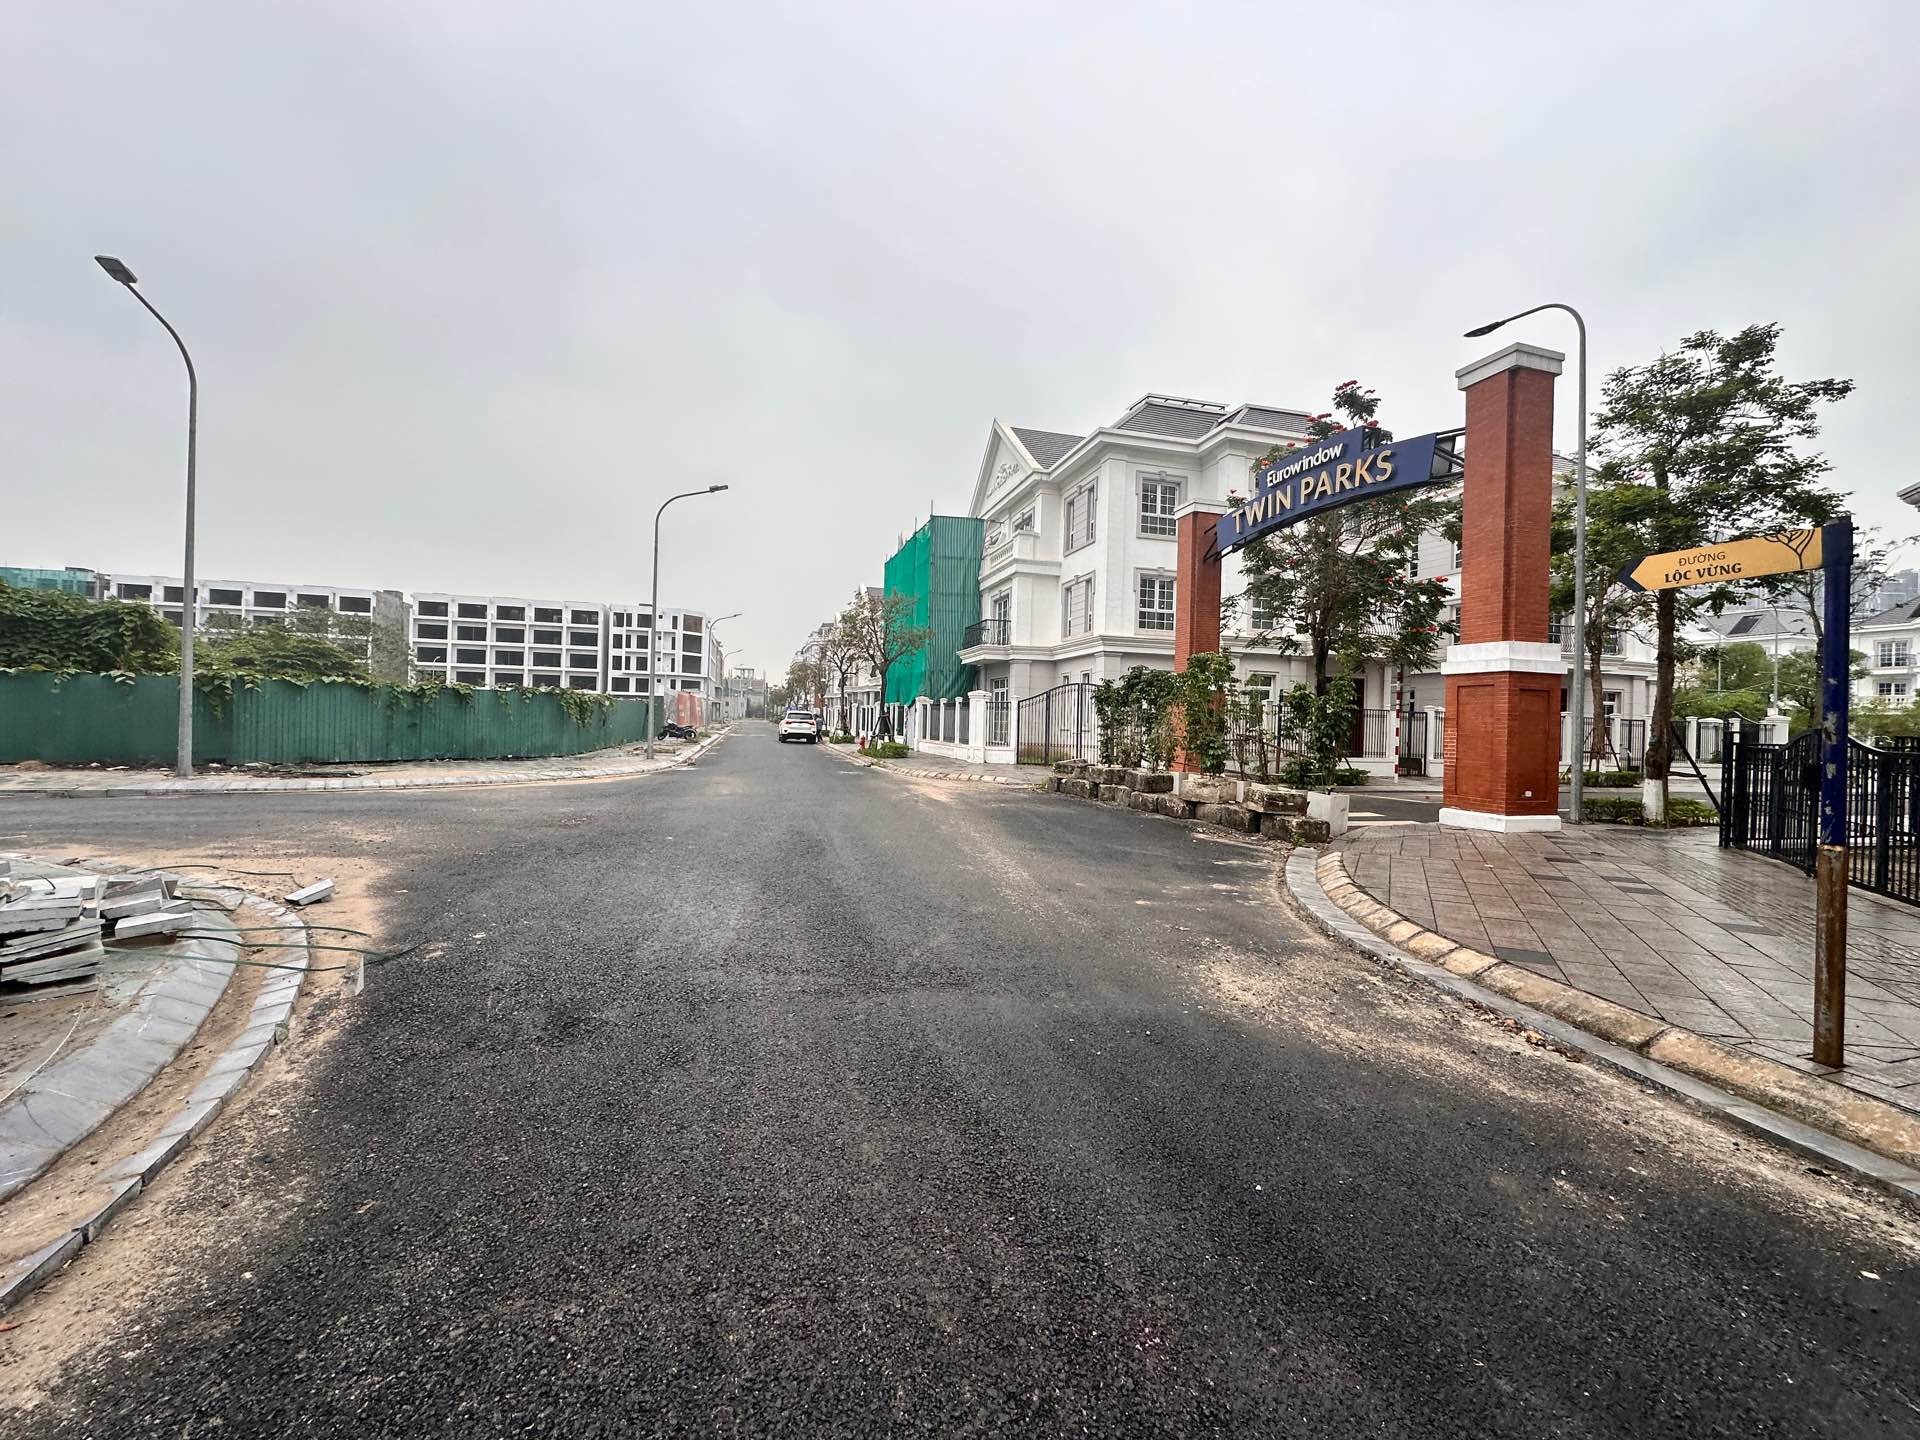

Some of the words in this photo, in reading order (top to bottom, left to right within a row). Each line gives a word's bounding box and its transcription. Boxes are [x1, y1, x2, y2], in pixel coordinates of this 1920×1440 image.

[1266, 443, 1344, 488] Eurowindow
[1231, 485, 1292, 534] TWIN
[1300, 449, 1394, 505] PARKS
[1664, 569, 1692, 584] LỘC
[1696, 562, 1742, 578] VỪNG
[1678, 551, 1726, 567] ĐƯỜNG
